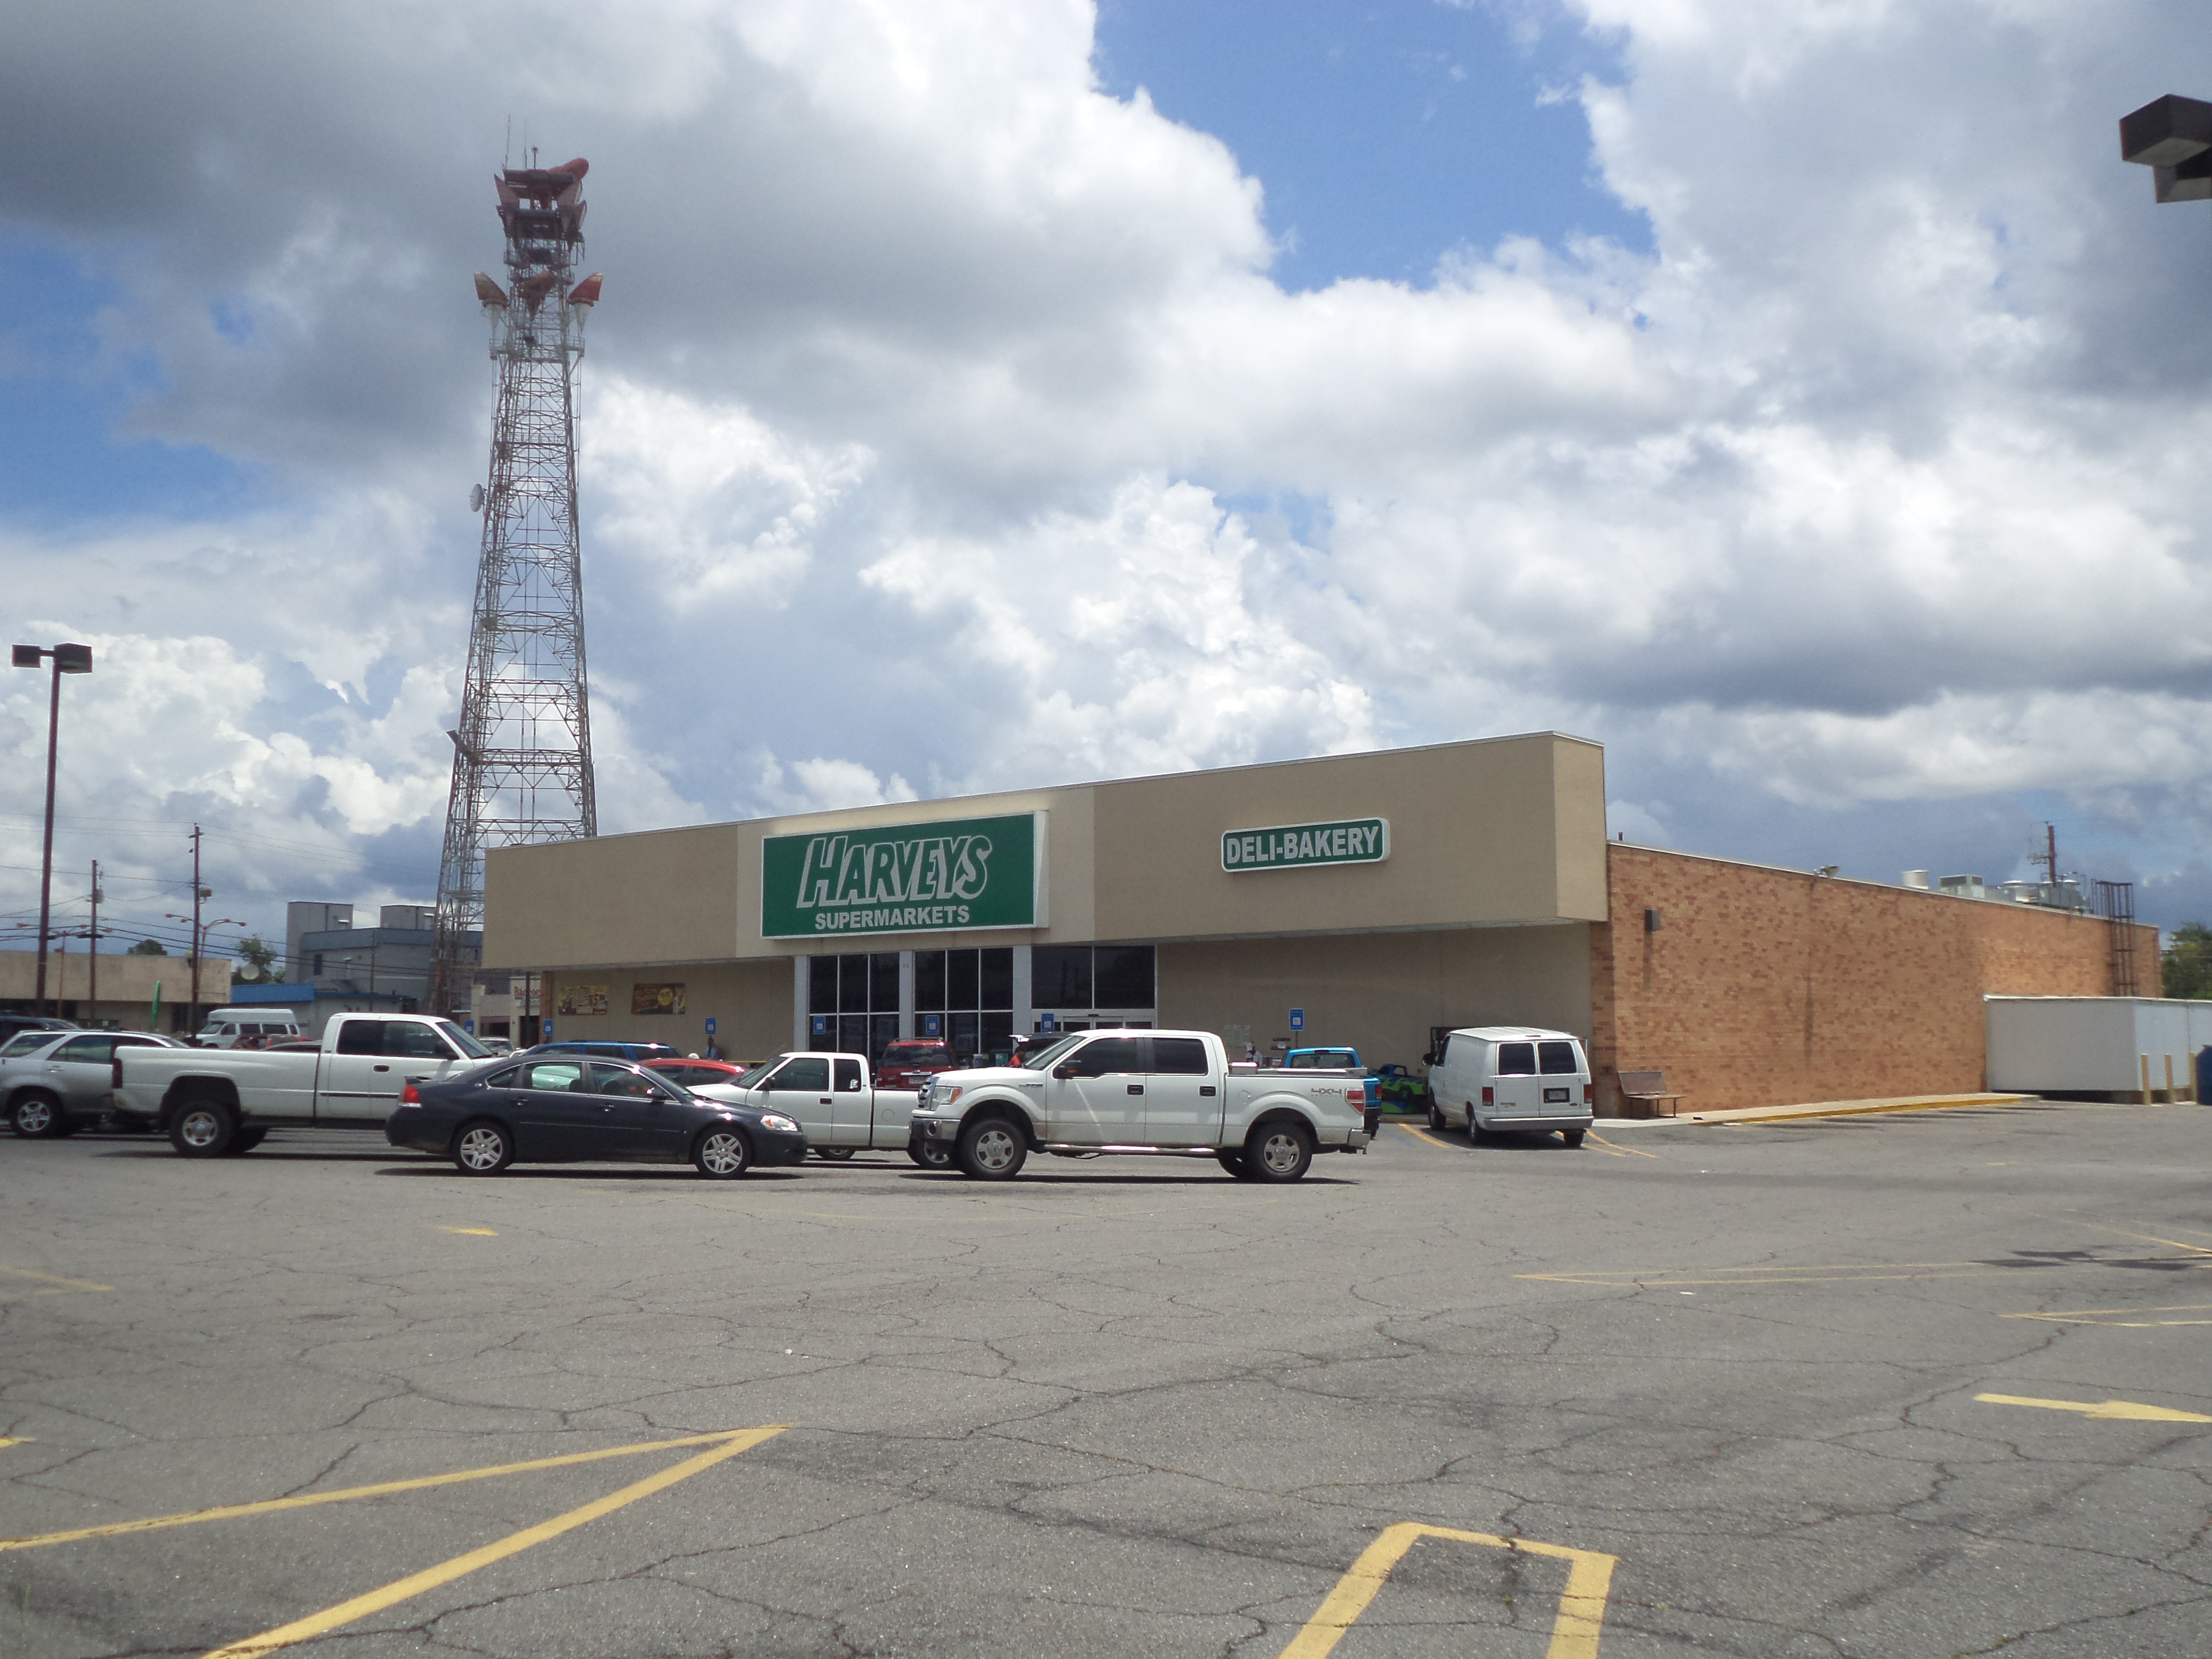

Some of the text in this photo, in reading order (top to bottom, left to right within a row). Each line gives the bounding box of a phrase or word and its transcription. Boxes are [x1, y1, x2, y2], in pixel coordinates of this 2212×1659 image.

[1227, 826, 1378, 863] DELI-BAKERY
[796, 835, 992, 908] HARVEYS
[815, 905, 969, 930] SUPERMARKETS
